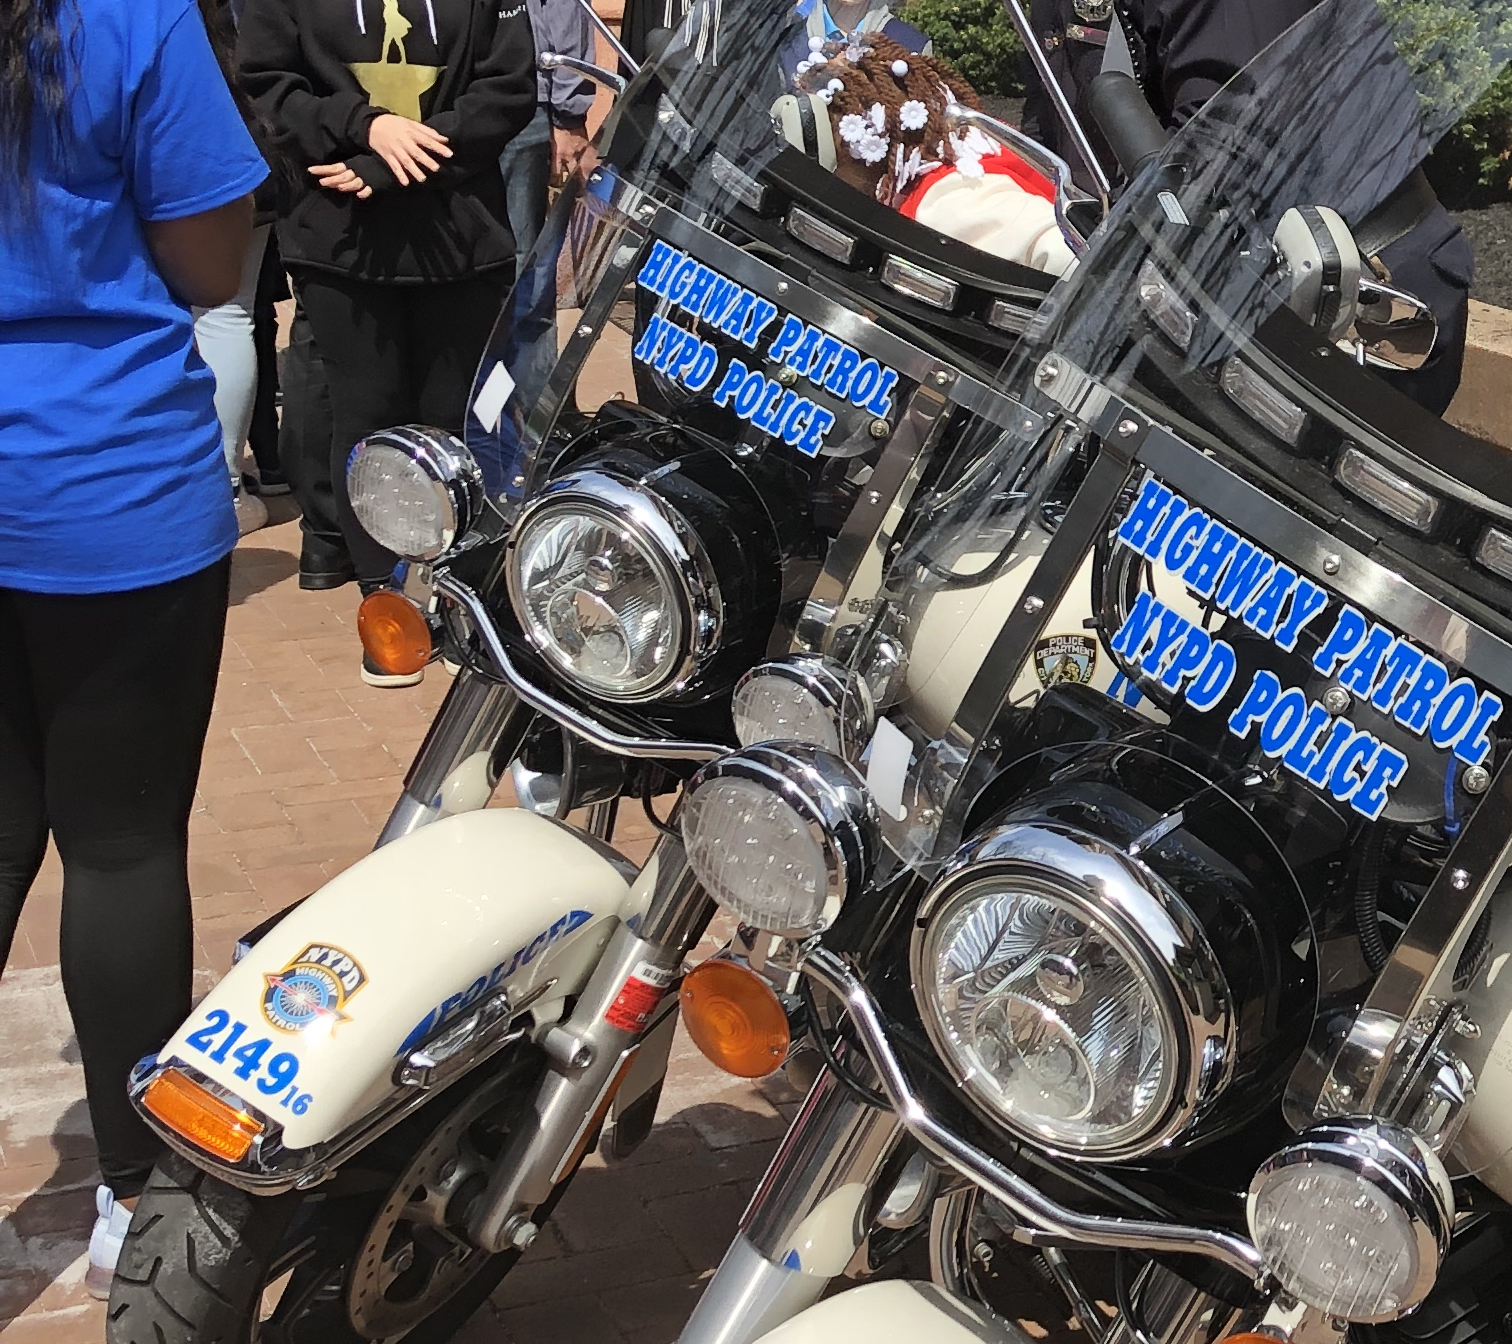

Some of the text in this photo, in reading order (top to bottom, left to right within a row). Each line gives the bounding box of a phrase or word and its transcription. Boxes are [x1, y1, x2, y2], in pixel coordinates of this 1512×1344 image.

[638, 239, 899, 419] HIGHWAY PATROL
[634, 313, 835, 458] NYPD POLICE
[1036, 645, 1095, 659] DEPARTMENT
[1049, 636, 1084, 646] POLICE
[1117, 478, 1503, 765] HIGHWAY PATROL
[1111, 592, 1408, 821] NYPD POLICE
[296, 967, 338, 996] HIGHWAY
[298, 947, 360, 991] NYPD
[264, 1002, 304, 1031] PATROL
[185, 1009, 313, 1116] 2149 16
